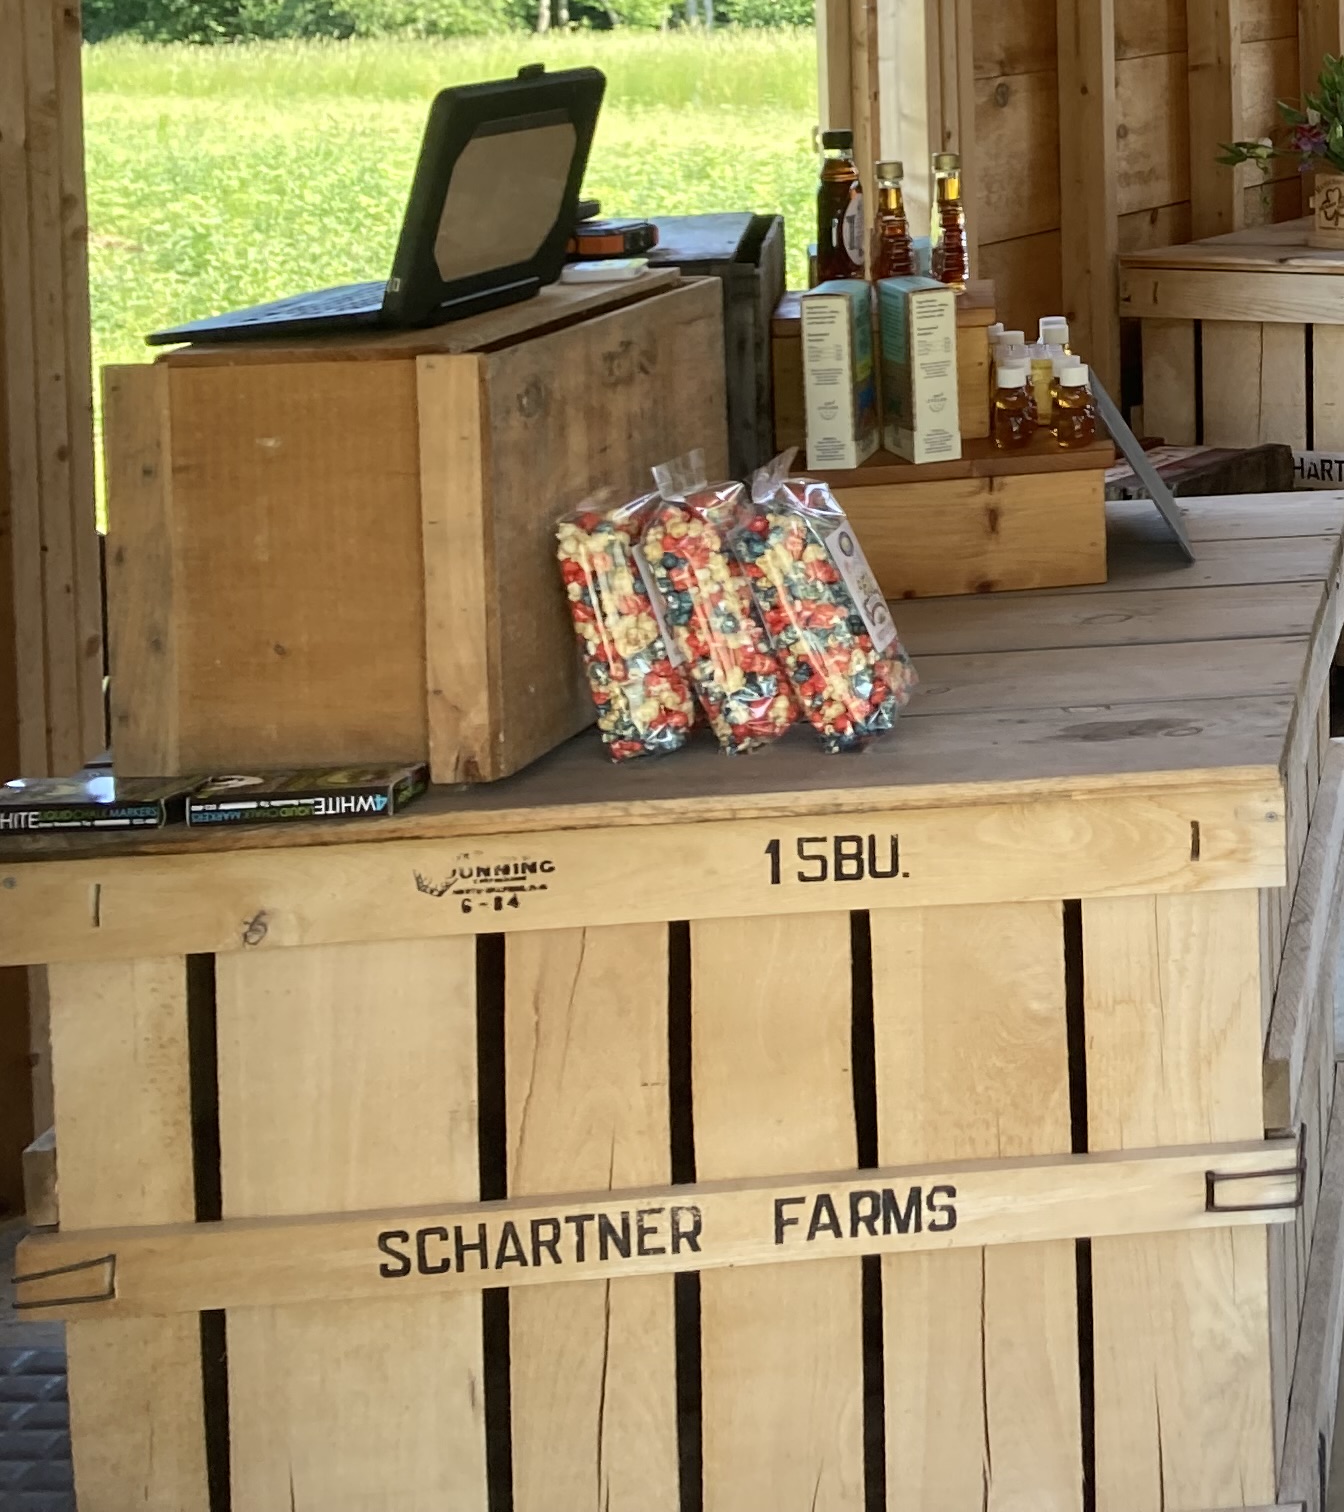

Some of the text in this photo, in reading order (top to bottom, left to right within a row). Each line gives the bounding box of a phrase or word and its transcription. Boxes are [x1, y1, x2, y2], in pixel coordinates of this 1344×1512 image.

[0, 811, 40, 830] HITE
[108, 806, 158, 818] MARKERS
[191, 811, 242, 823] MARKERS
[377, 1185, 958, 1278] SCHARTNER FARMS
